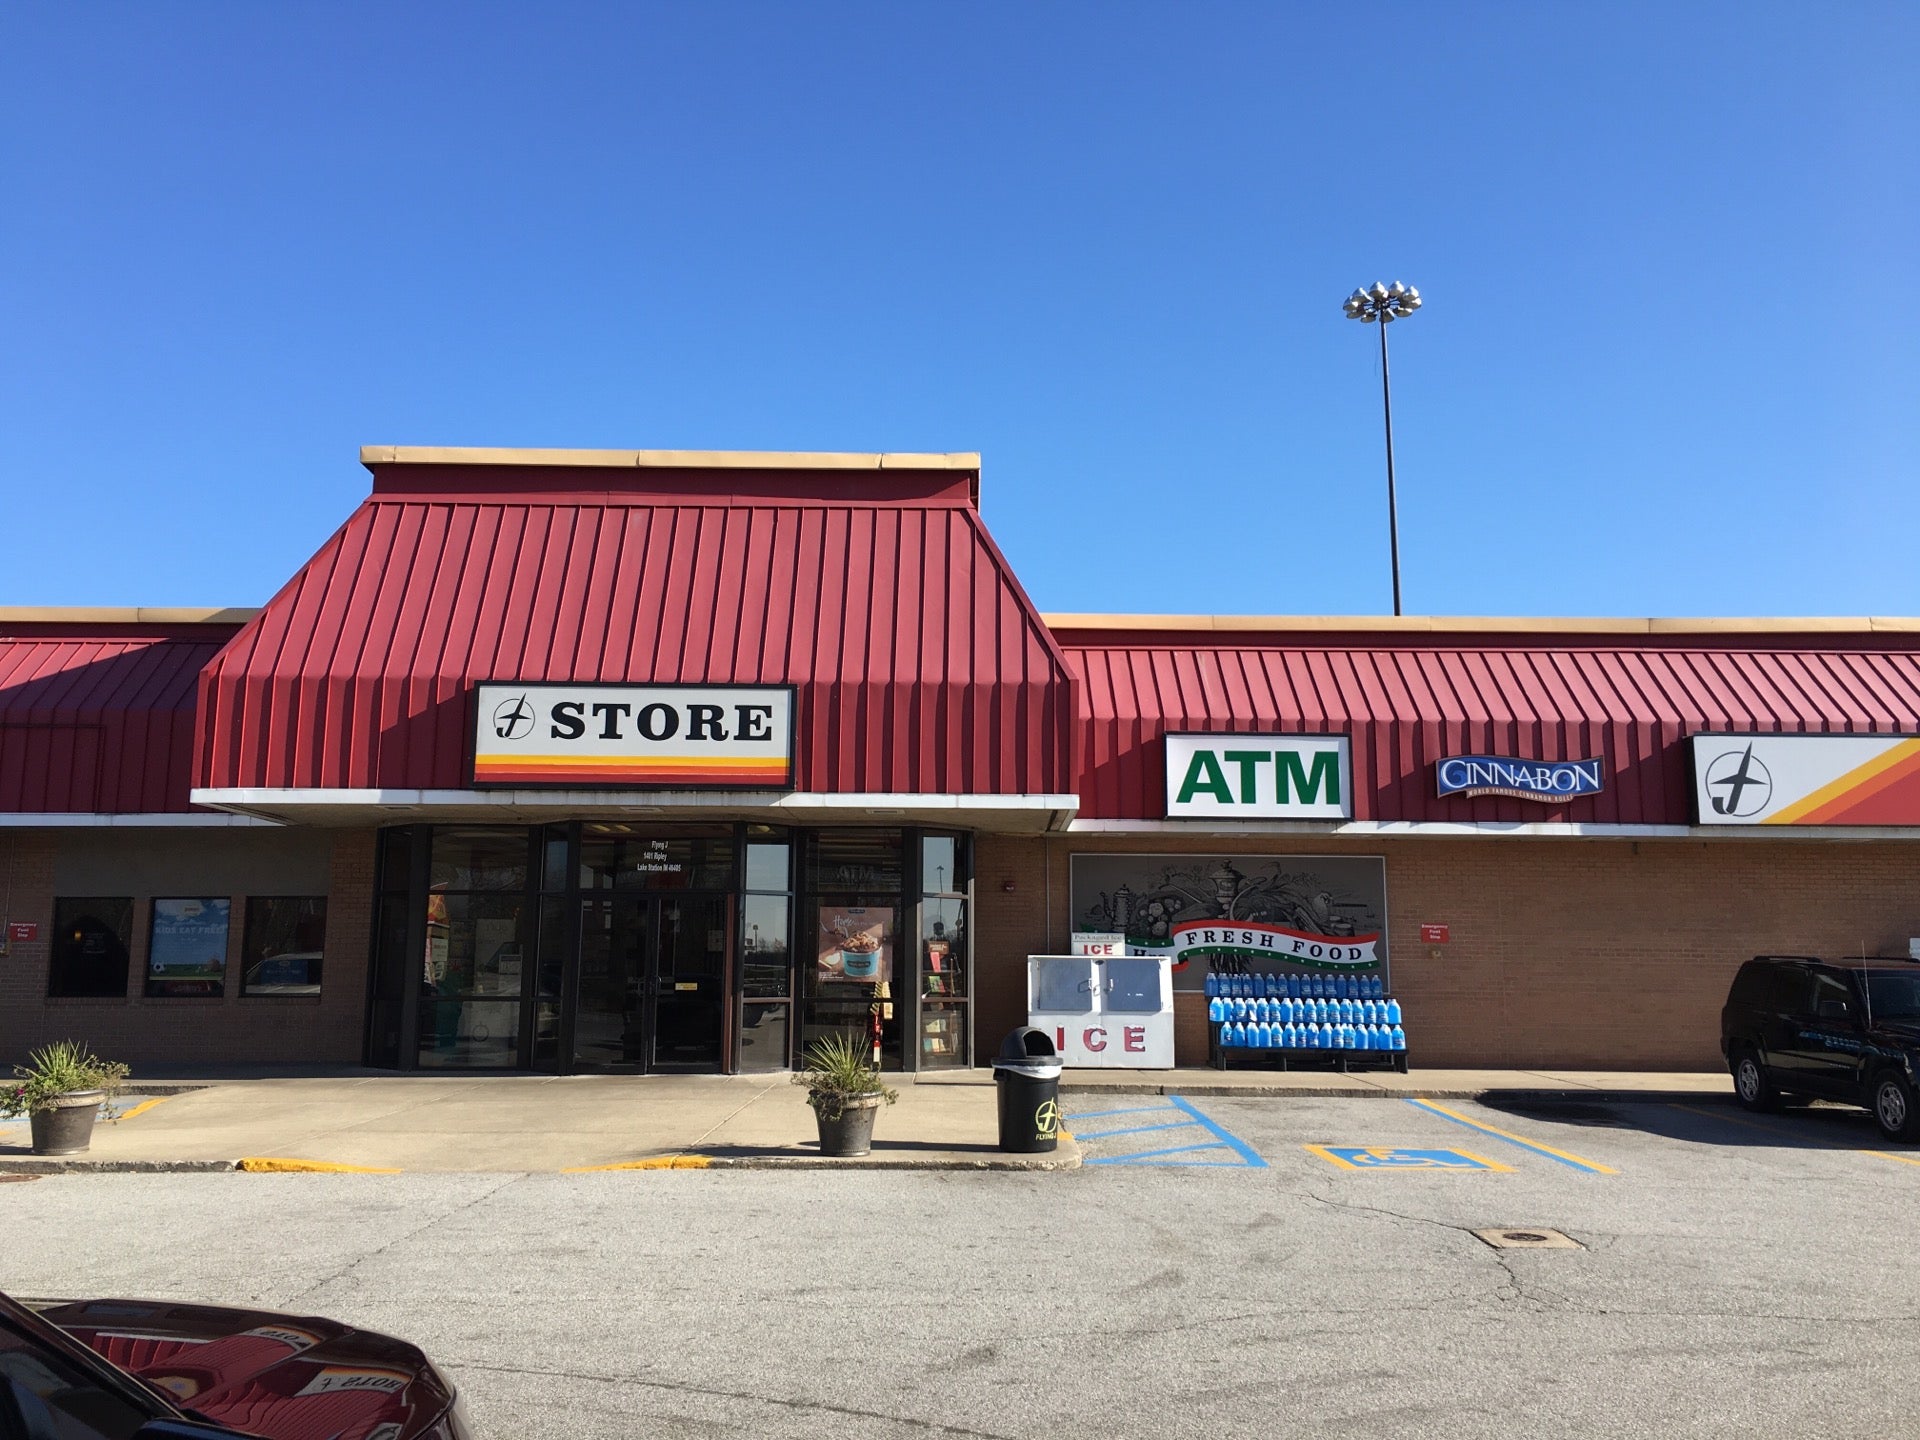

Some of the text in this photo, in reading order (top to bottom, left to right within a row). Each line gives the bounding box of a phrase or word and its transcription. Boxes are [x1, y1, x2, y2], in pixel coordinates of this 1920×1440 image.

[550, 701, 773, 742] STORE
[1175, 750, 1341, 805] ATM
[1440, 760, 1600, 791] CINNABON
[1468, 788, 1490, 797] WORLD
[1492, 787, 1517, 796] FAMOUS
[1519, 790, 1552, 801] CINNAMON
[1083, 943, 1113, 955] ICE
[1185, 930, 1363, 961] FRESH FOOD
[1056, 1023, 1146, 1053] ICE
